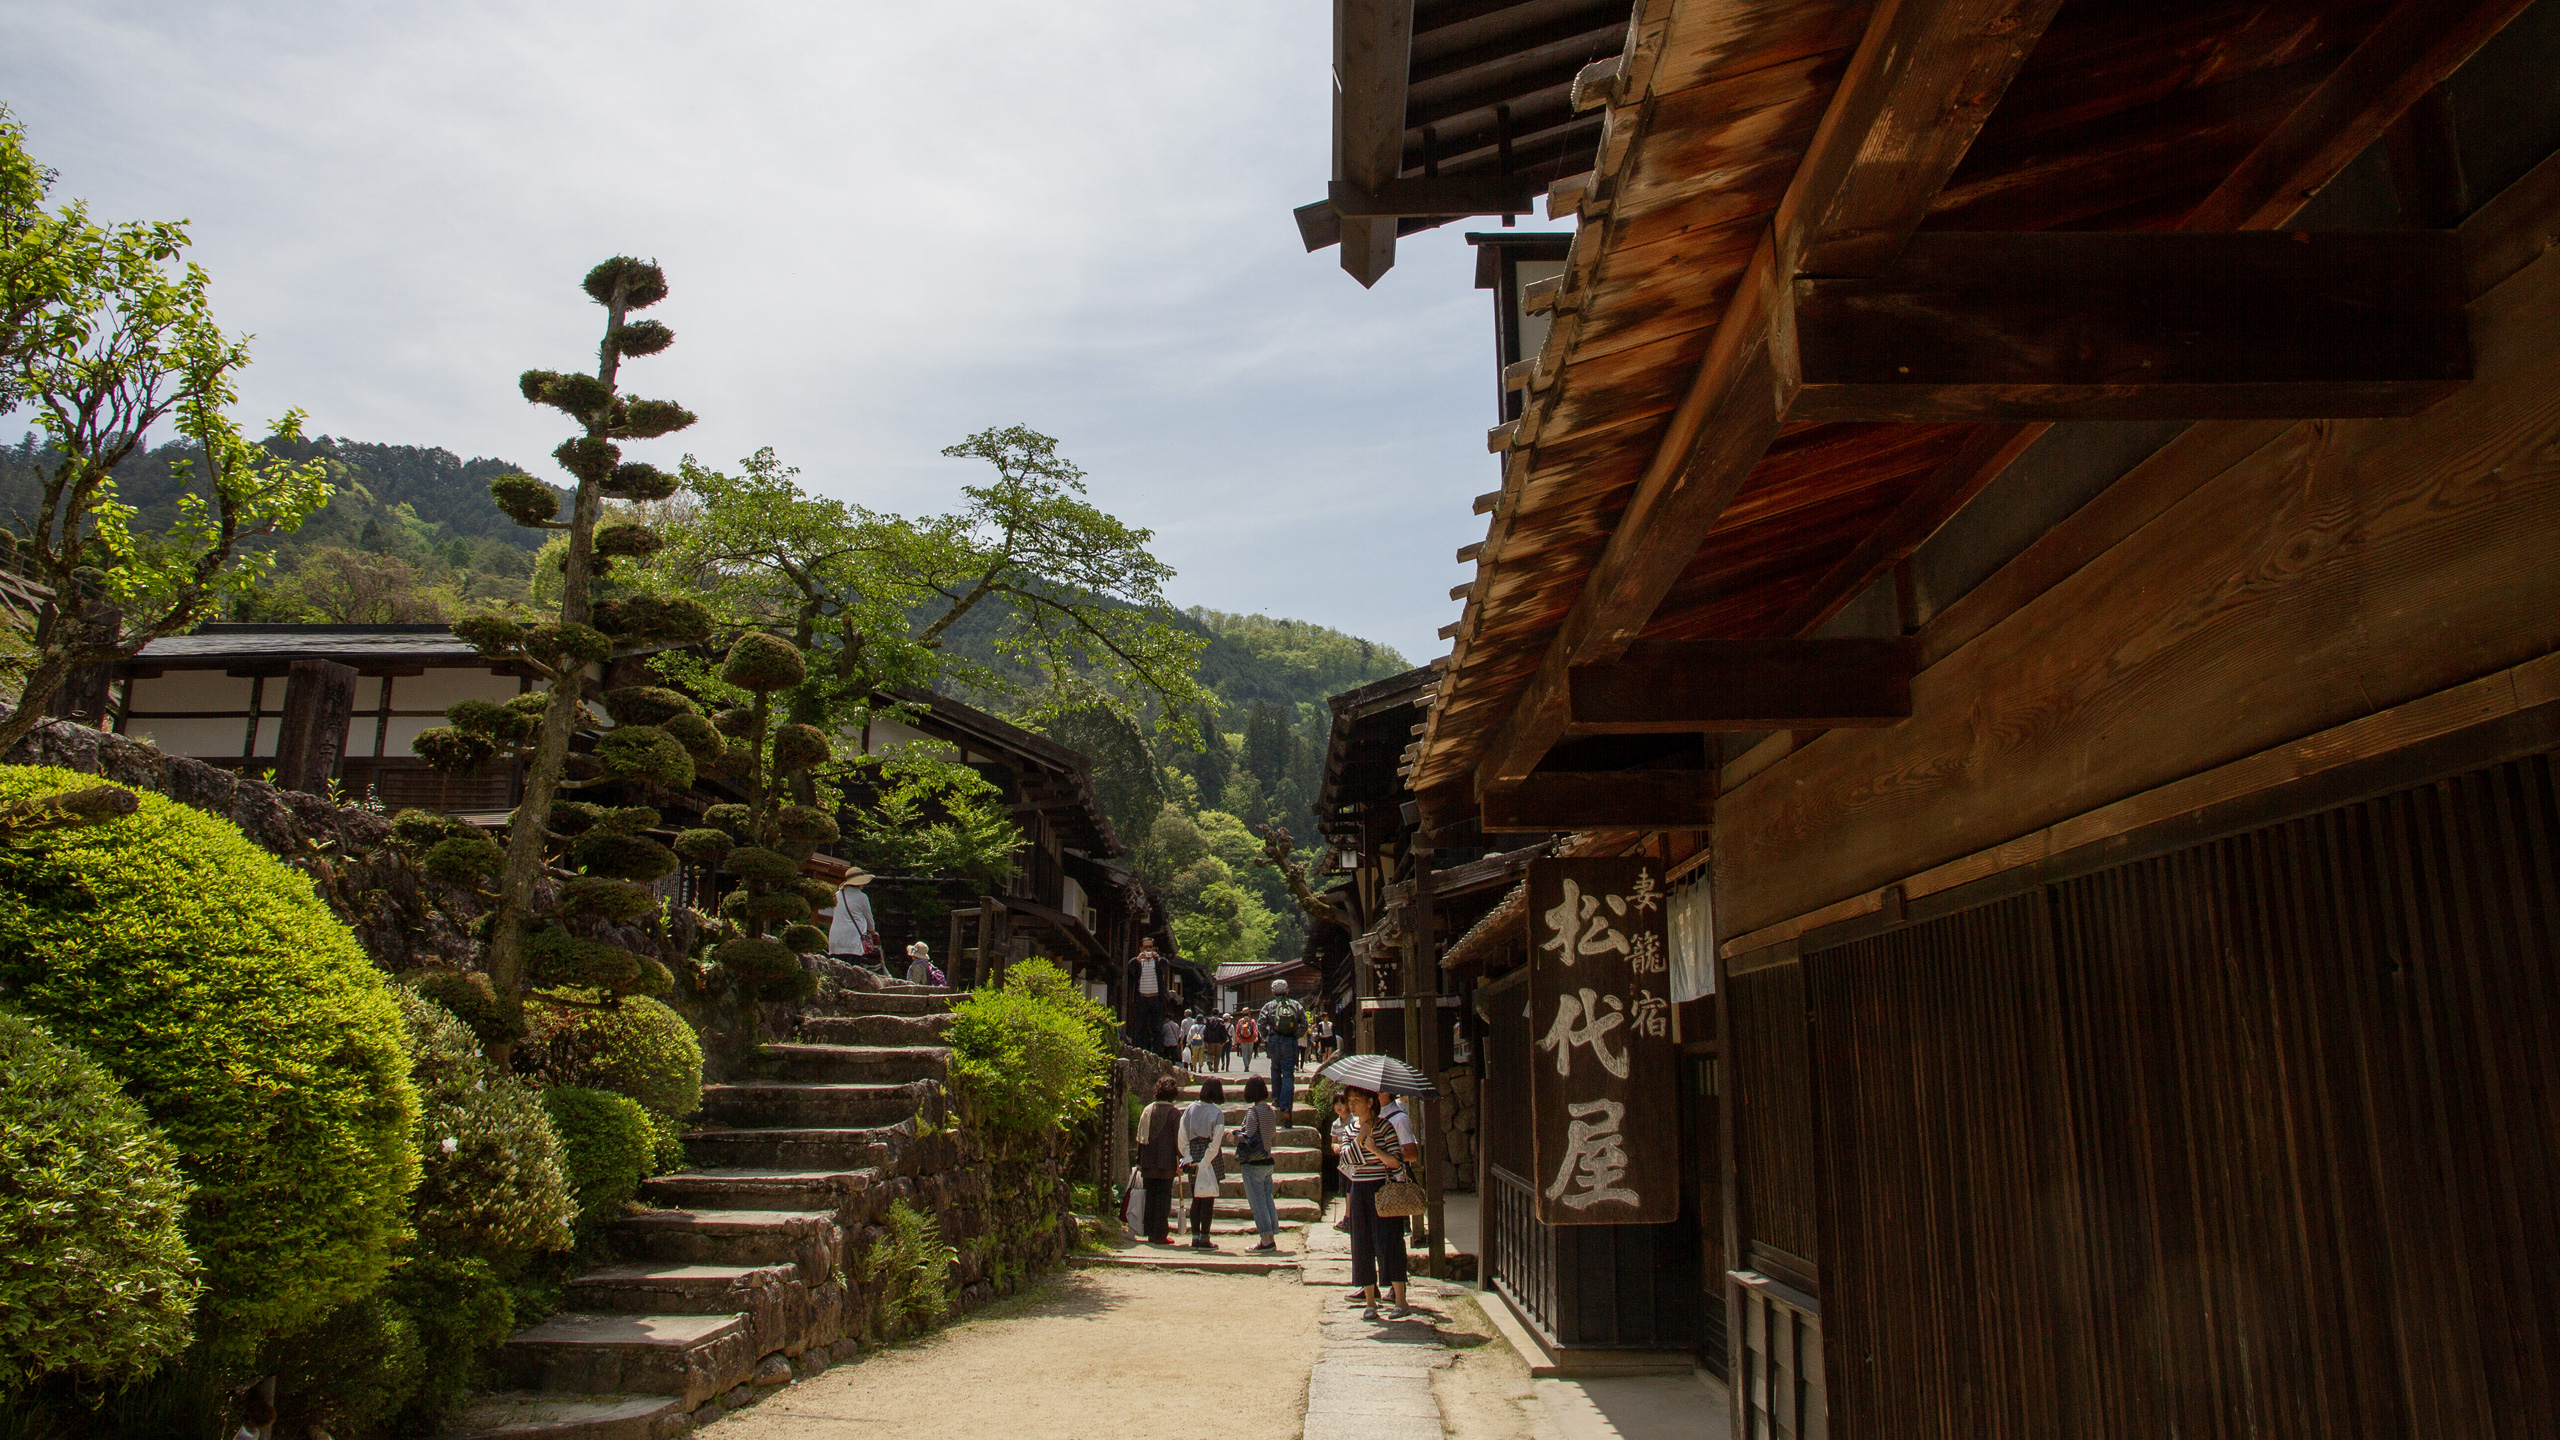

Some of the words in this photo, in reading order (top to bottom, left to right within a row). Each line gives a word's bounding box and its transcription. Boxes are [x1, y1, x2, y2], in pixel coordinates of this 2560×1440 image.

[1535, 878, 1641, 1211] 松代屋
[1624, 866, 1667, 1038] 妻籠宿
